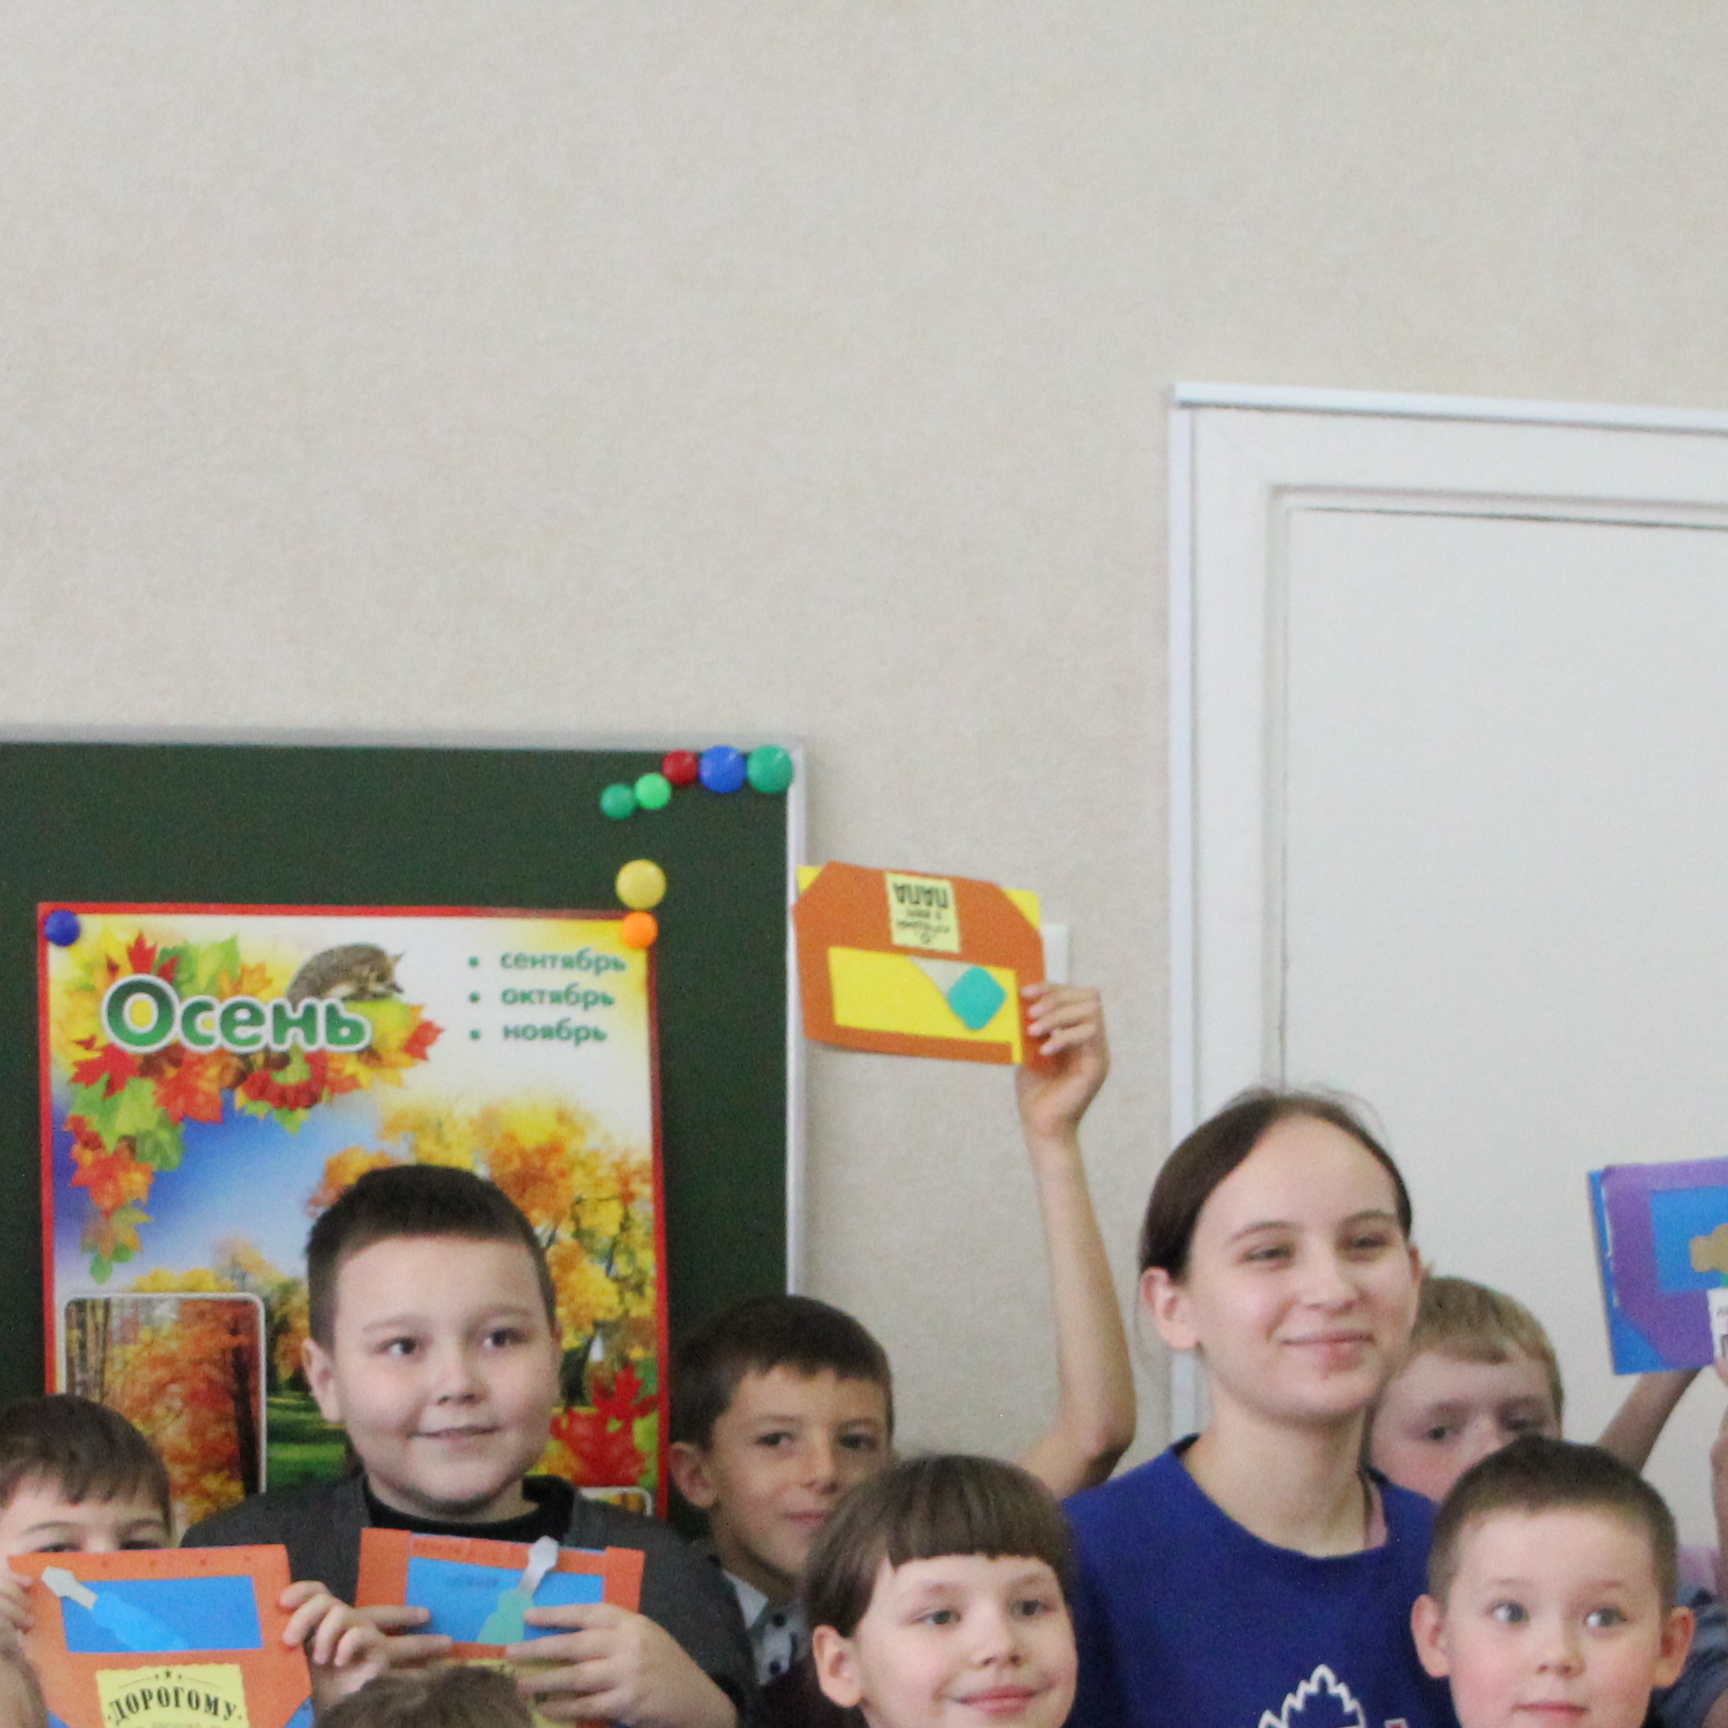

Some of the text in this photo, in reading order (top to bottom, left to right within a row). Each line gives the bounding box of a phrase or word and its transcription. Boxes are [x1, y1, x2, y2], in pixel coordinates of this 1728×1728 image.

[500, 946, 627, 976] сентябрь
[501, 982, 615, 1011] октябрь
[104, 974, 372, 1053] Осень
[503, 1017, 607, 1047] ноябрь
[109, 1686, 236, 1727] ДОРОГОМУ
